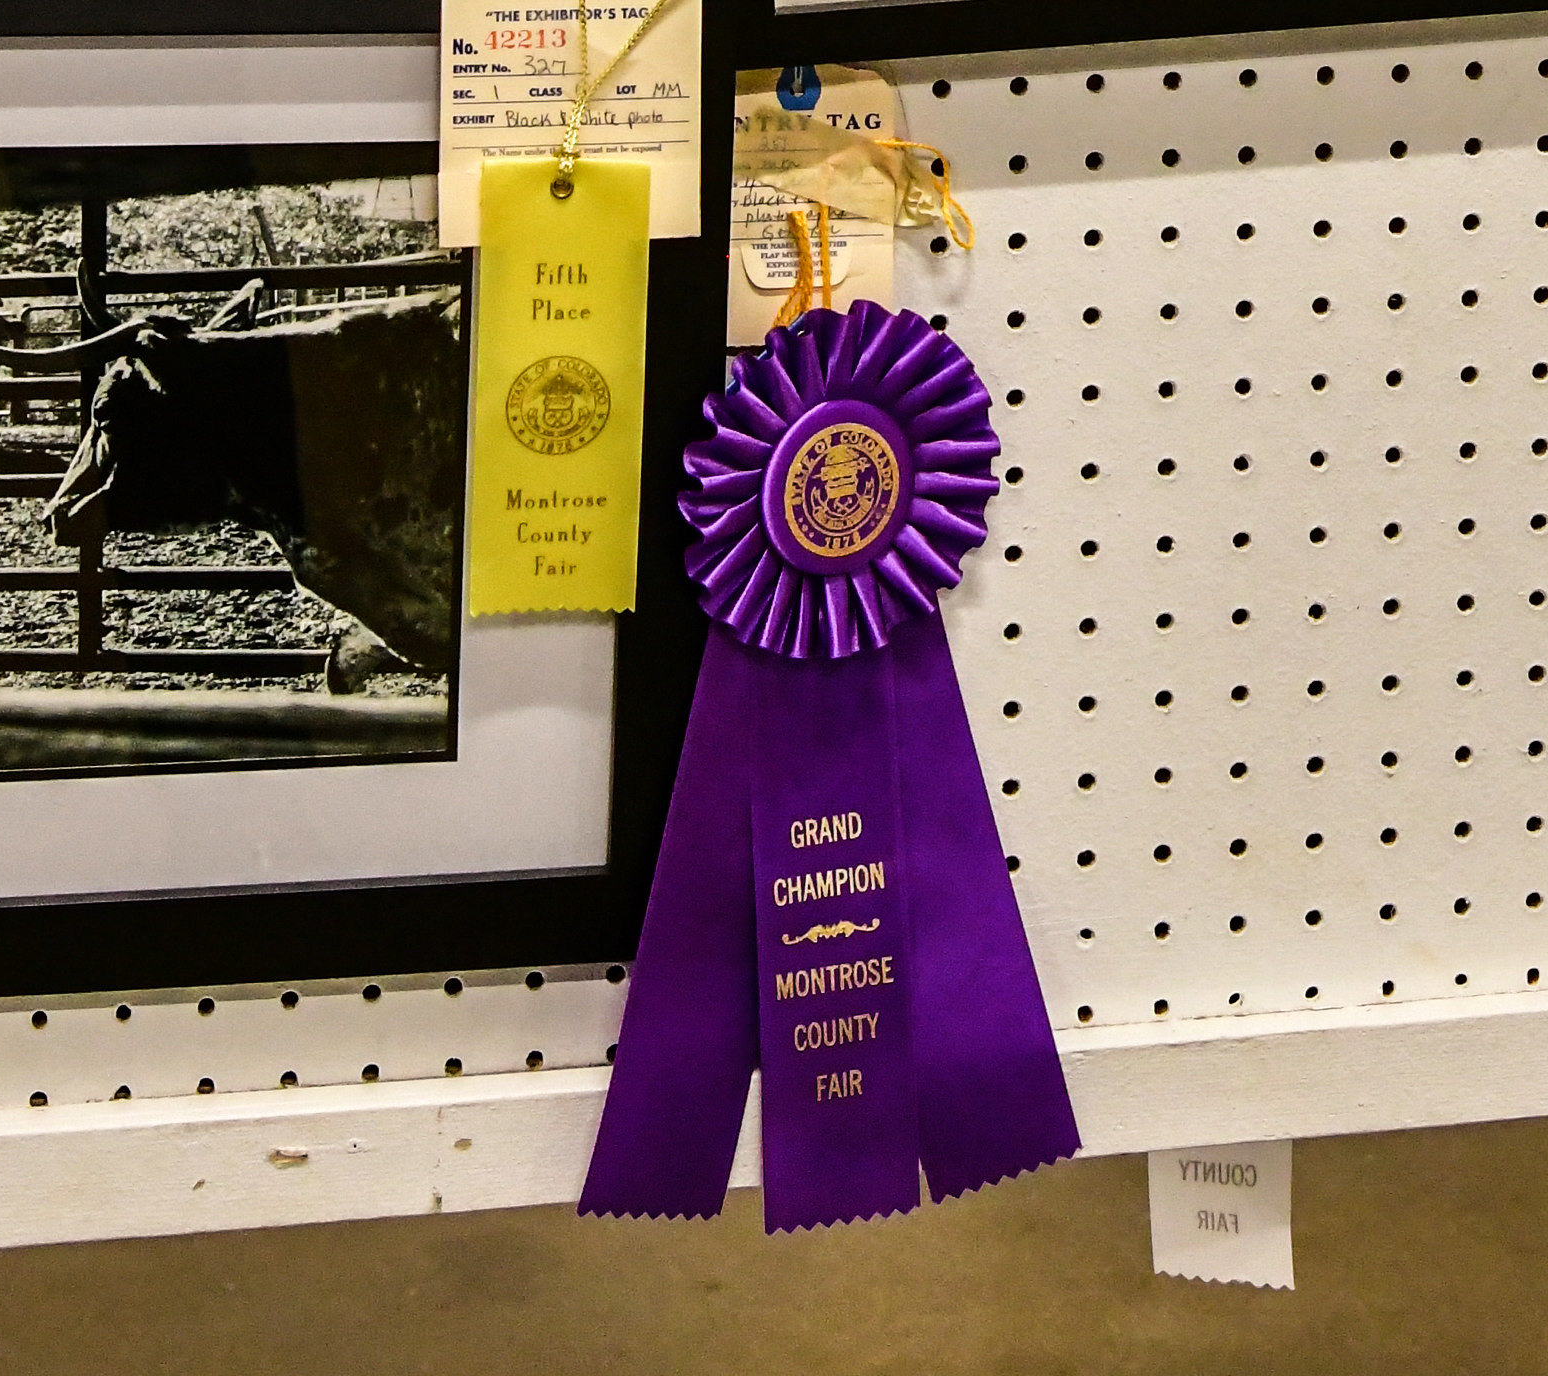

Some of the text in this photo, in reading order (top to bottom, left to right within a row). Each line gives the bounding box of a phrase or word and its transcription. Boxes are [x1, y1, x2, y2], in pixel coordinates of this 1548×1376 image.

[452, 28, 567, 55] No. 42213
[453, 55, 567, 76] ENTRY No. 327
[453, 89, 476, 99] SEC.
[529, 87, 563, 97] CLASS
[616, 85, 637, 95] LOT
[452, 115, 495, 125] EXHIBIT
[505, 110, 552, 127] Black
[628, 114, 663, 129] photo
[826, 113, 882, 130] TAG
[536, 262, 588, 285] Fifth
[532, 298, 591, 321] Place
[506, 489, 607, 510] Montrose
[517, 522, 592, 545] County
[534, 555, 577, 576] Fair
[790, 811, 863, 848] GRAND
[773, 861, 886, 907] CHAMPION
[775, 956, 895, 1000] MONTROSE
[794, 1012, 880, 1052] COUNTY
[816, 1069, 864, 1102] FAIR
